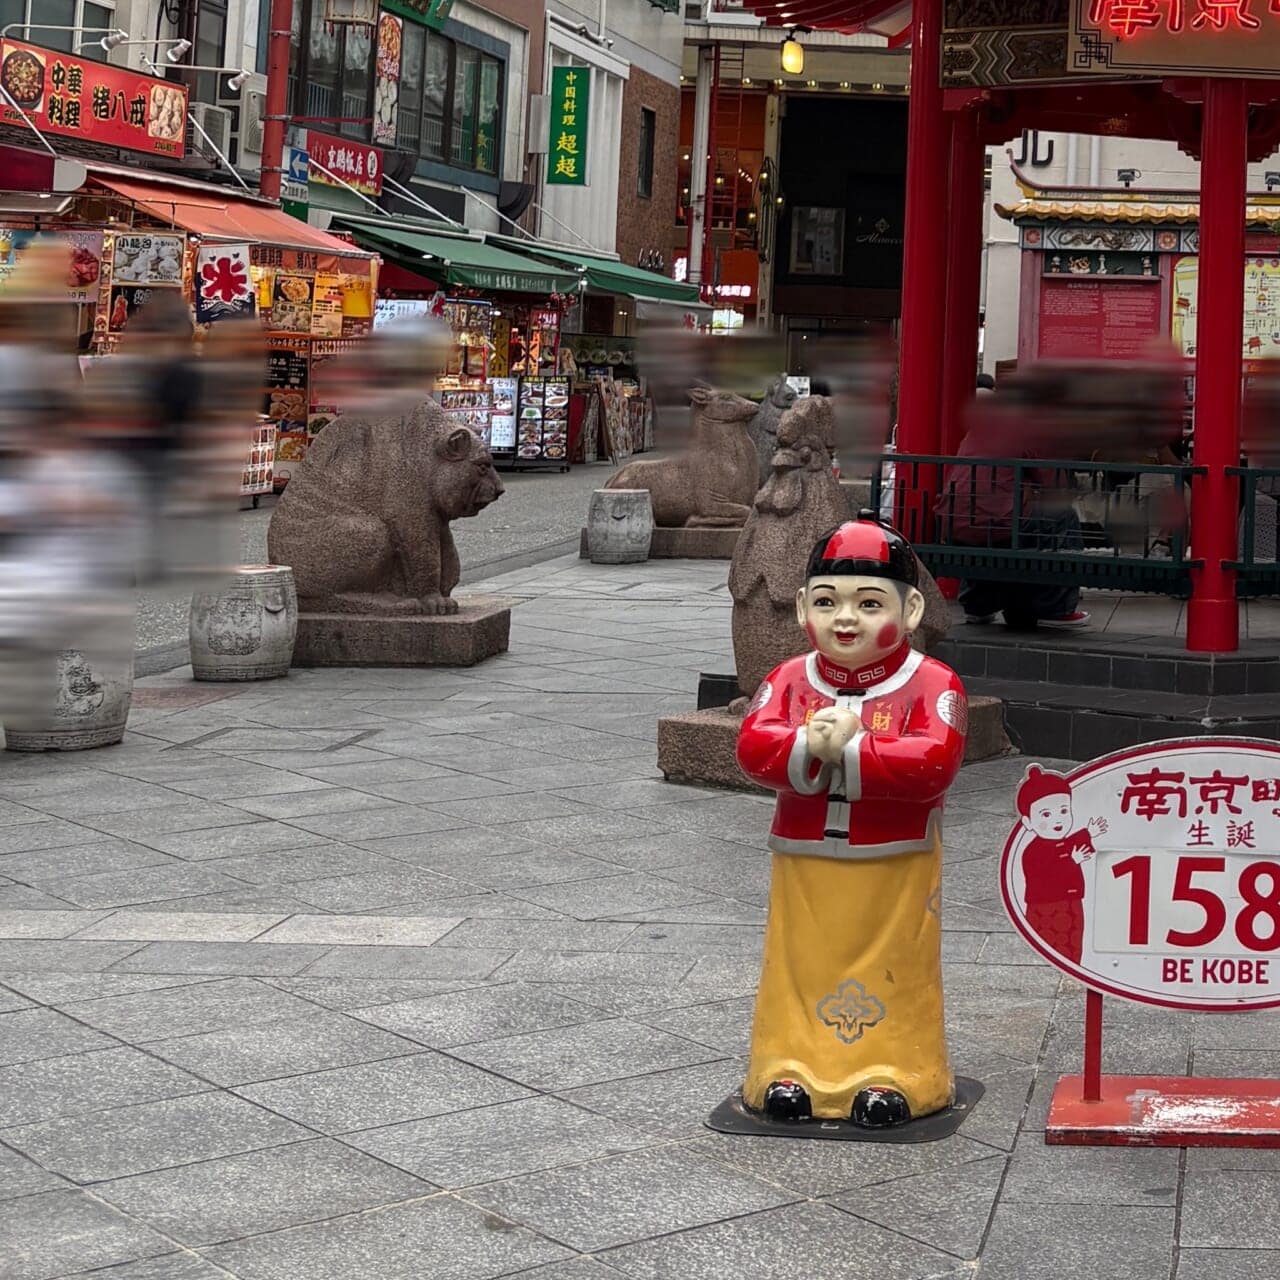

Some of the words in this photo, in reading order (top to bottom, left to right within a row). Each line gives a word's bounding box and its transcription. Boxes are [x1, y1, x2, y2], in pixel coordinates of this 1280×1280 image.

[51, 62, 82, 95] 中華
[48, 96, 81, 129] 料理
[93, 86, 146, 128] 猪八戒
[561, 71, 578, 126] 中国料理
[555, 131, 579, 178] 超超
[871, 711, 894, 732] 財
[1186, 821, 1257, 849] 生誕
[1161, 959, 1194, 983] BE
[1201, 960, 1270, 985] KOBE
